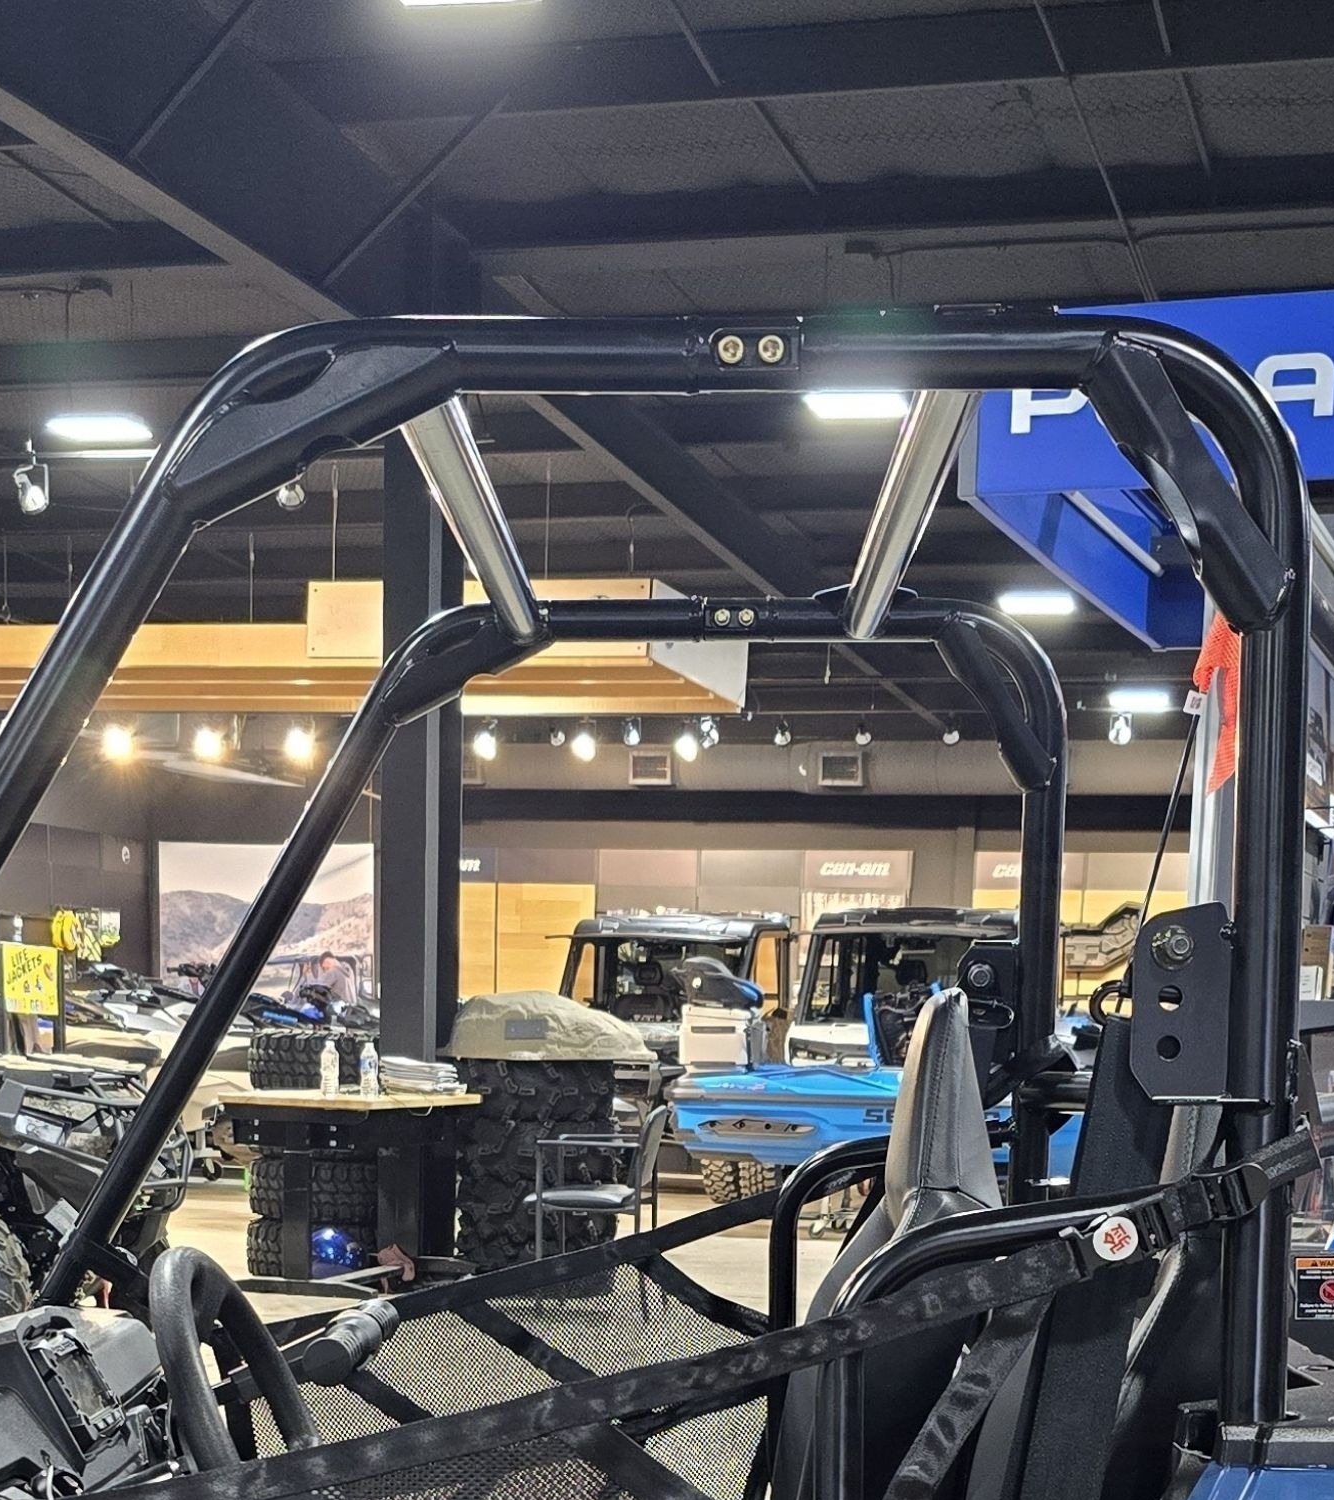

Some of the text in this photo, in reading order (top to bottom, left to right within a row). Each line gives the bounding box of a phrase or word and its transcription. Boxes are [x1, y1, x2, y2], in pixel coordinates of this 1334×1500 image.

[819, 861, 891, 877] can-am
[11, 948, 28, 968] LIFE
[6, 954, 42, 985] JACKETS
